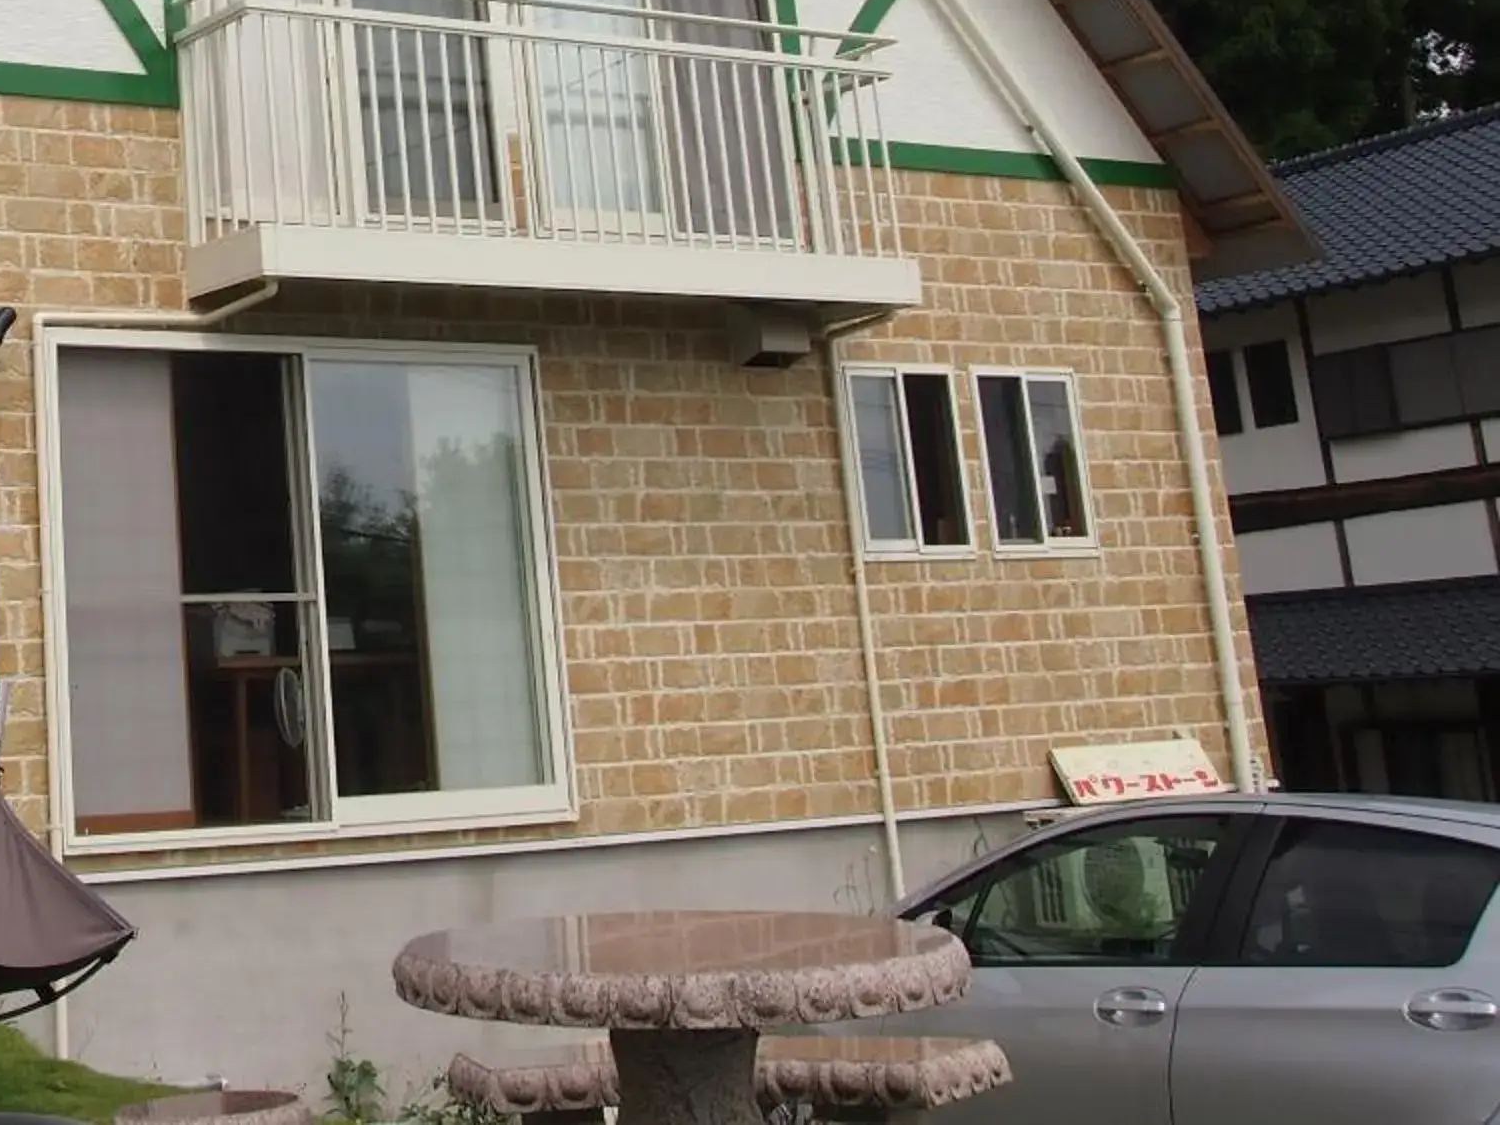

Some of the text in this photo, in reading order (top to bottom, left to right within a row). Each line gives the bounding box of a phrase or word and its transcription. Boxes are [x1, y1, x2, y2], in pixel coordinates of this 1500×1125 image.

[1073, 769, 1219, 798] パワーストーン
